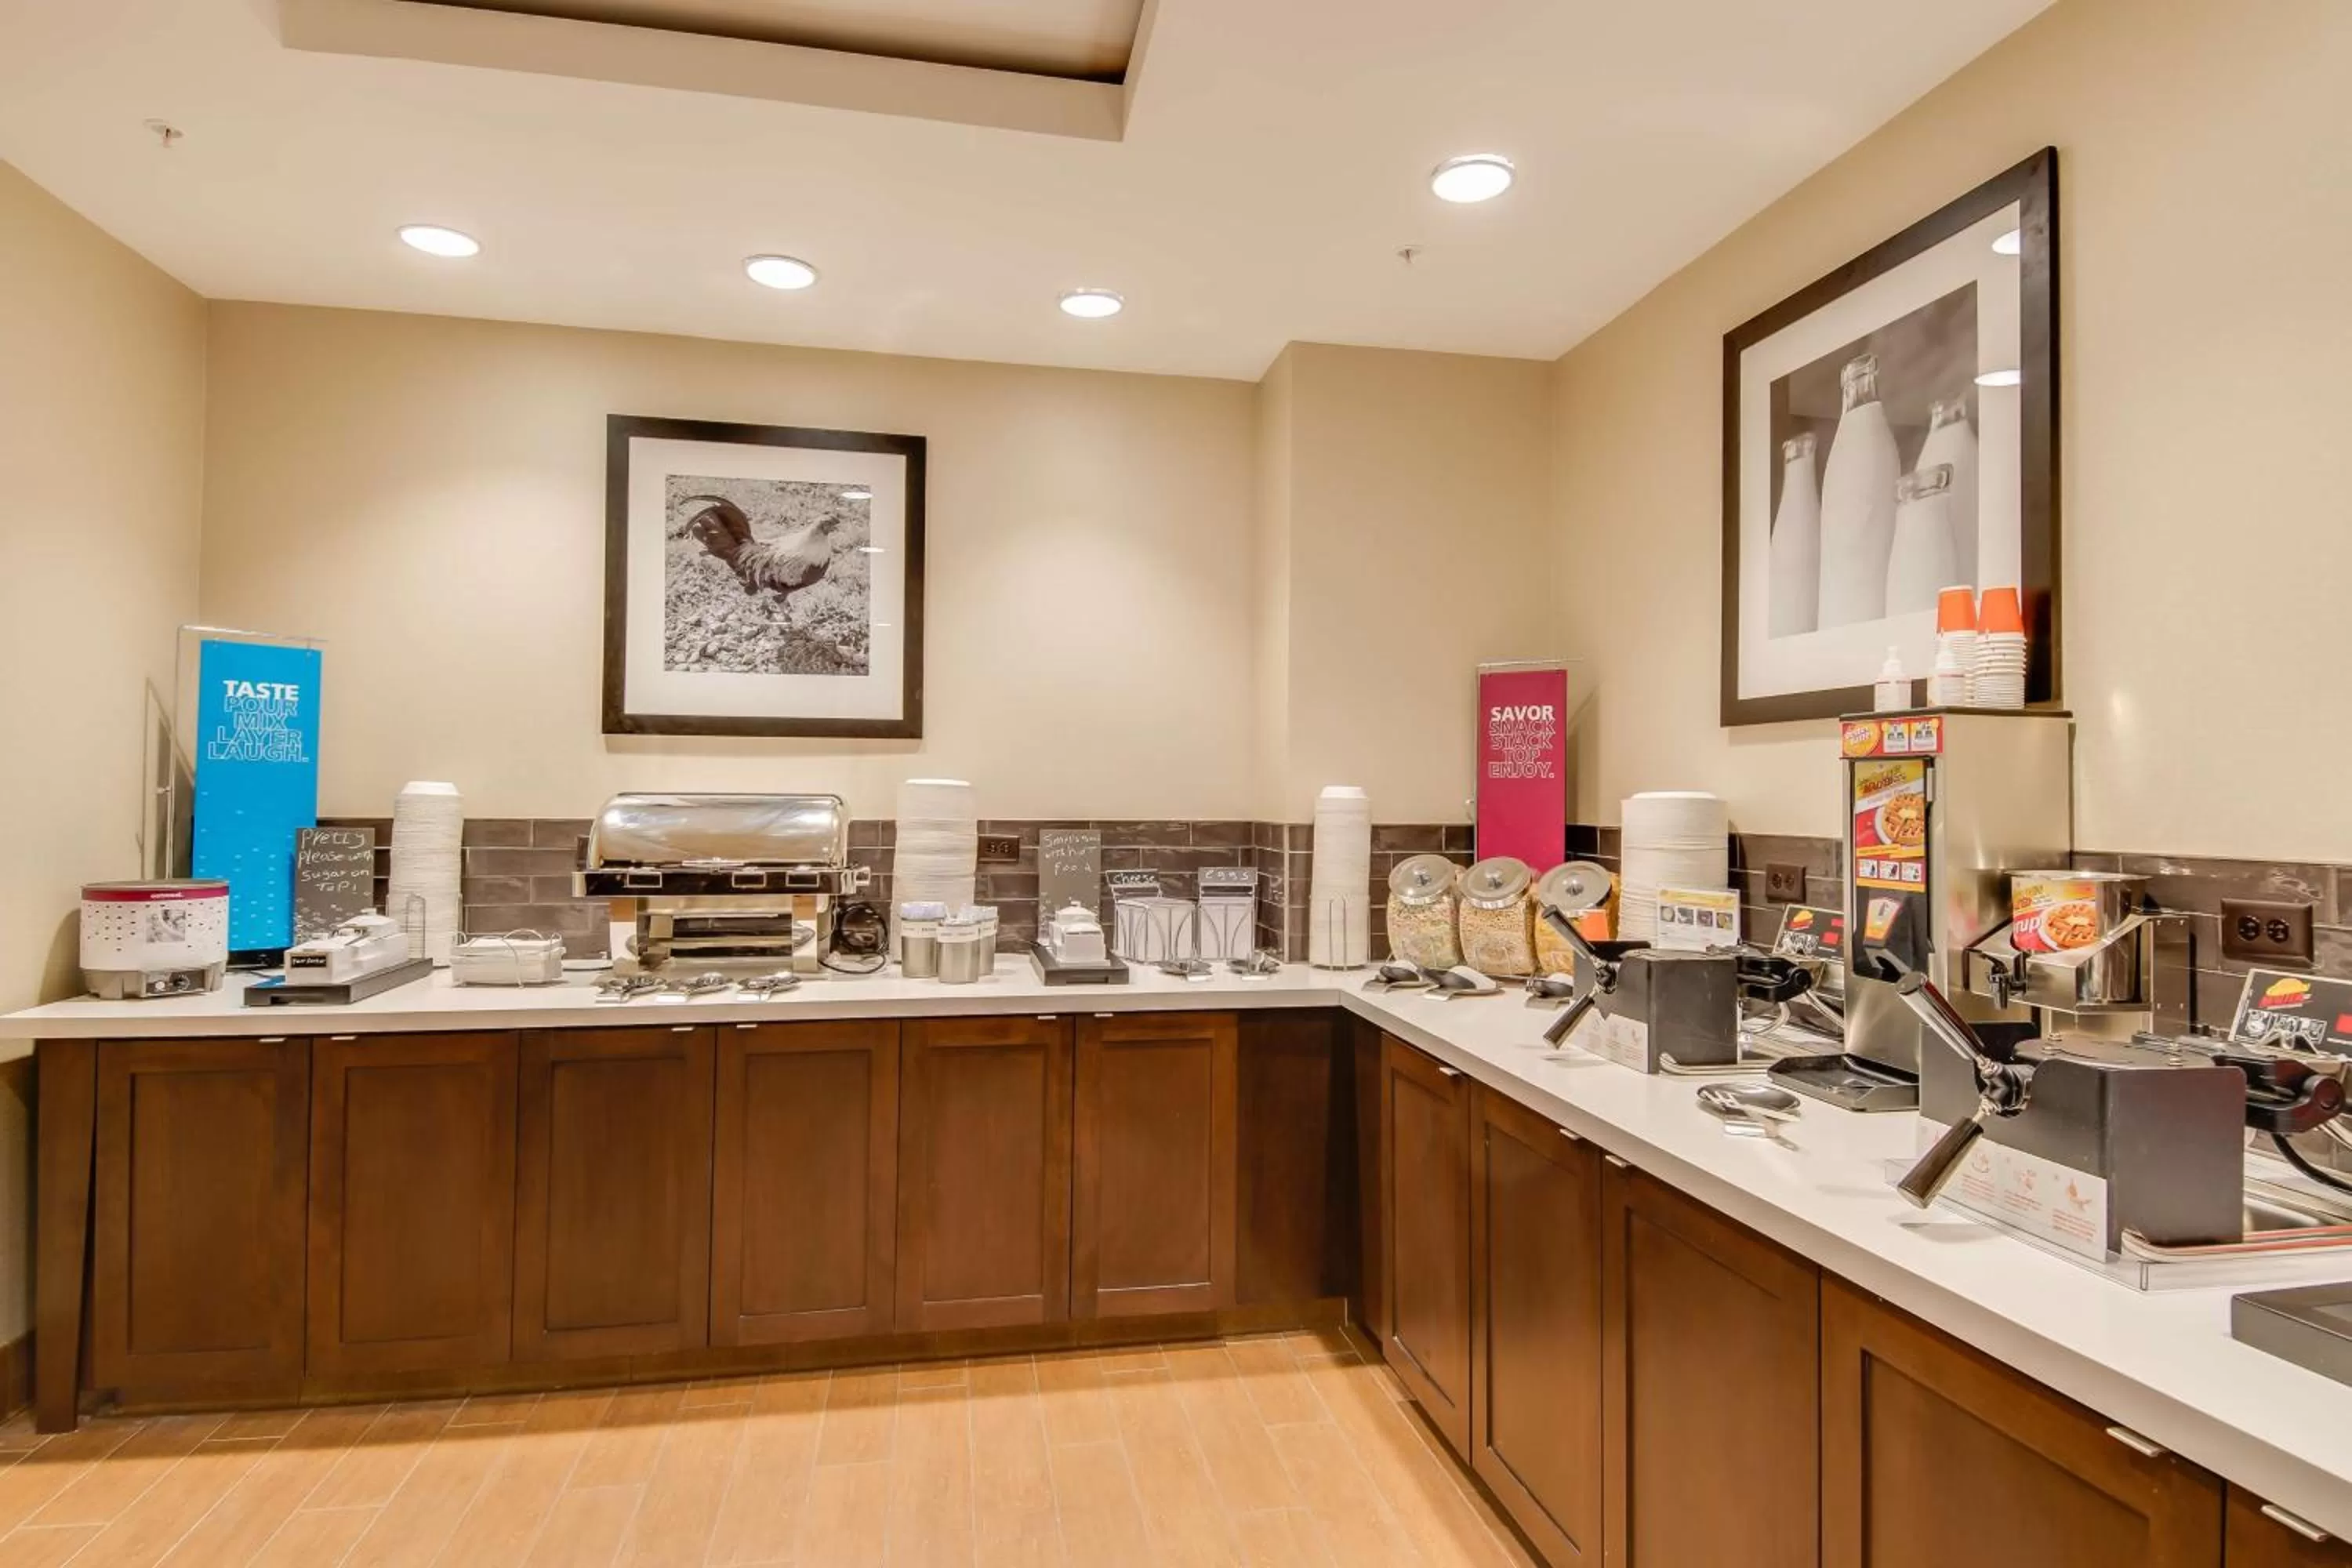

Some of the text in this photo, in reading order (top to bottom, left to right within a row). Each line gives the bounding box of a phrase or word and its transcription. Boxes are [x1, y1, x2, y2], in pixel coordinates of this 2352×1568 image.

[223, 681, 299, 701] TASTE
[224, 695, 297, 717] POUR
[1491, 706, 1555, 720] SAVOR
[234, 712, 287, 731] MIX
[1490, 720, 1555, 735] SNACK
[217, 726, 302, 748] LAYER
[1491, 734, 1553, 750] STACK
[208, 741, 310, 762] LAUGH.
[1502, 747, 1541, 764] TOP
[1488, 761, 1555, 779] ENJOY.
